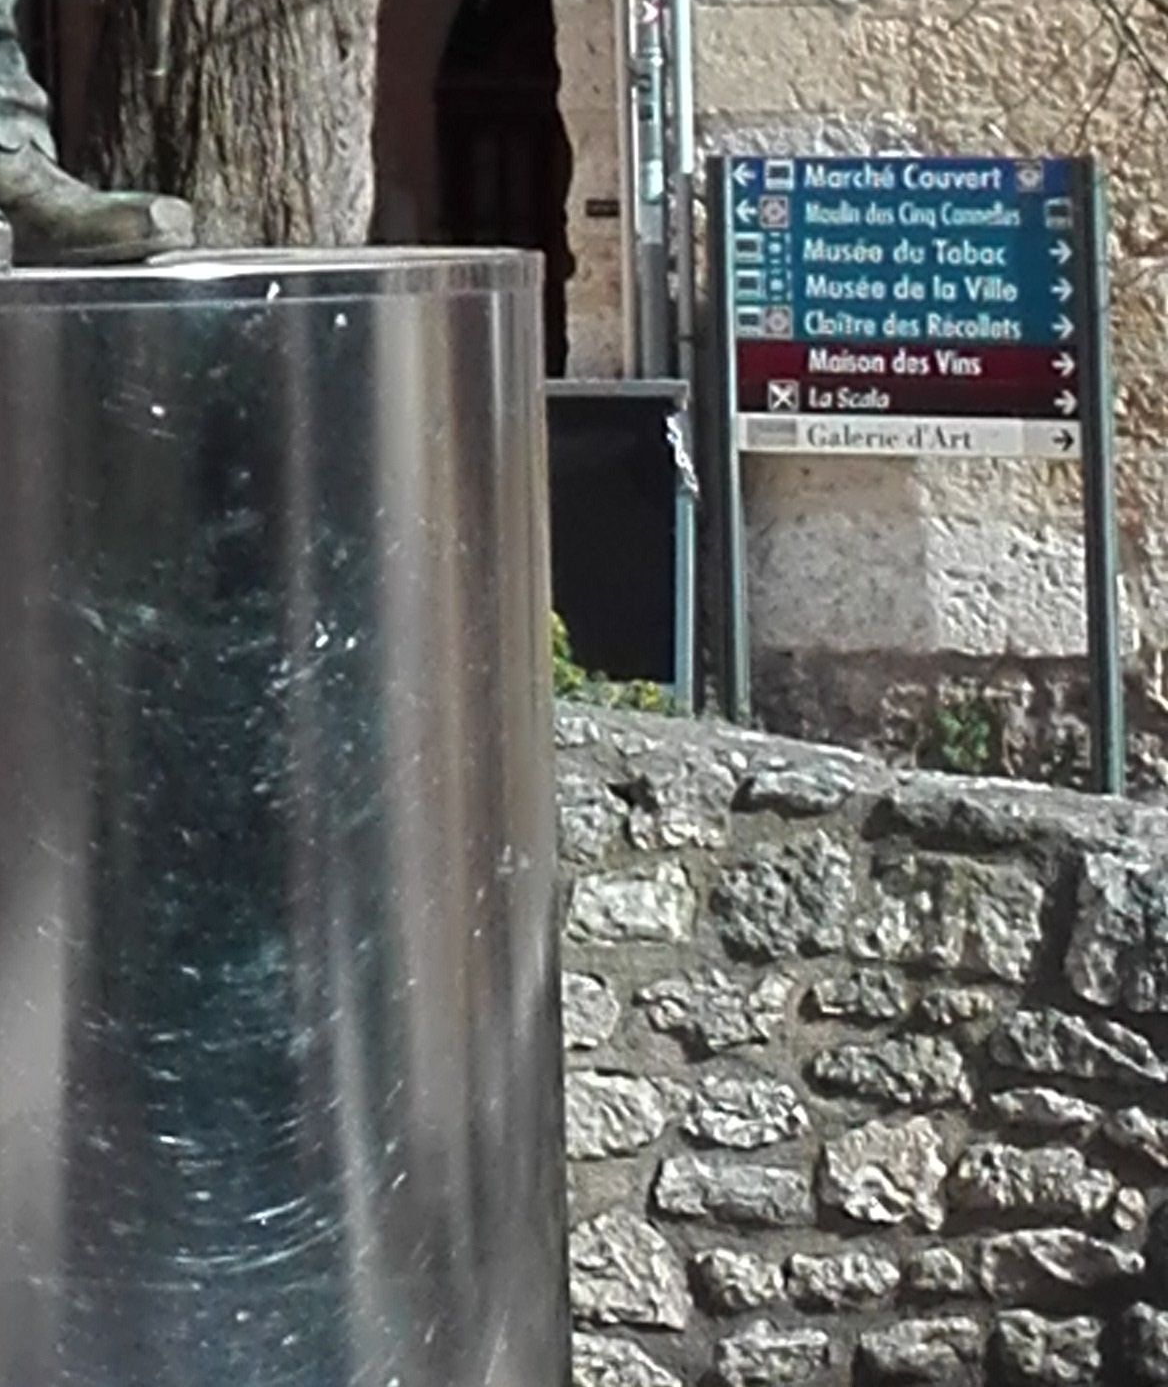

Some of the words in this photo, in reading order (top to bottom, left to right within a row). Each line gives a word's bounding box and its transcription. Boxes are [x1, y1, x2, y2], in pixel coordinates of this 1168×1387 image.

[804, 163, 895, 189] Marché
[903, 163, 1002, 189] Couvert
[805, 200, 860, 224] Moulin
[865, 201, 895, 225] des
[898, 201, 937, 228] Cinq
[803, 237, 884, 263] Musée
[892, 238, 925, 264] du
[933, 239, 1007, 266] Tabac
[805, 274, 886, 300] Musée
[893, 275, 926, 300] de
[933, 275, 957, 301] la
[963, 275, 1018, 302] Ville
[804, 310, 876, 335] Cloître
[882, 312, 920, 337] des
[927, 311, 1022, 339] Récollets
[808, 348, 885, 374] Maison
[891, 348, 930, 374] des
[935, 349, 982, 376] Vins
[808, 387, 832, 408] La
[837, 387, 890, 409] Scala
[806, 424, 899, 448] Galerie
[906, 425, 971, 450] d'Art
